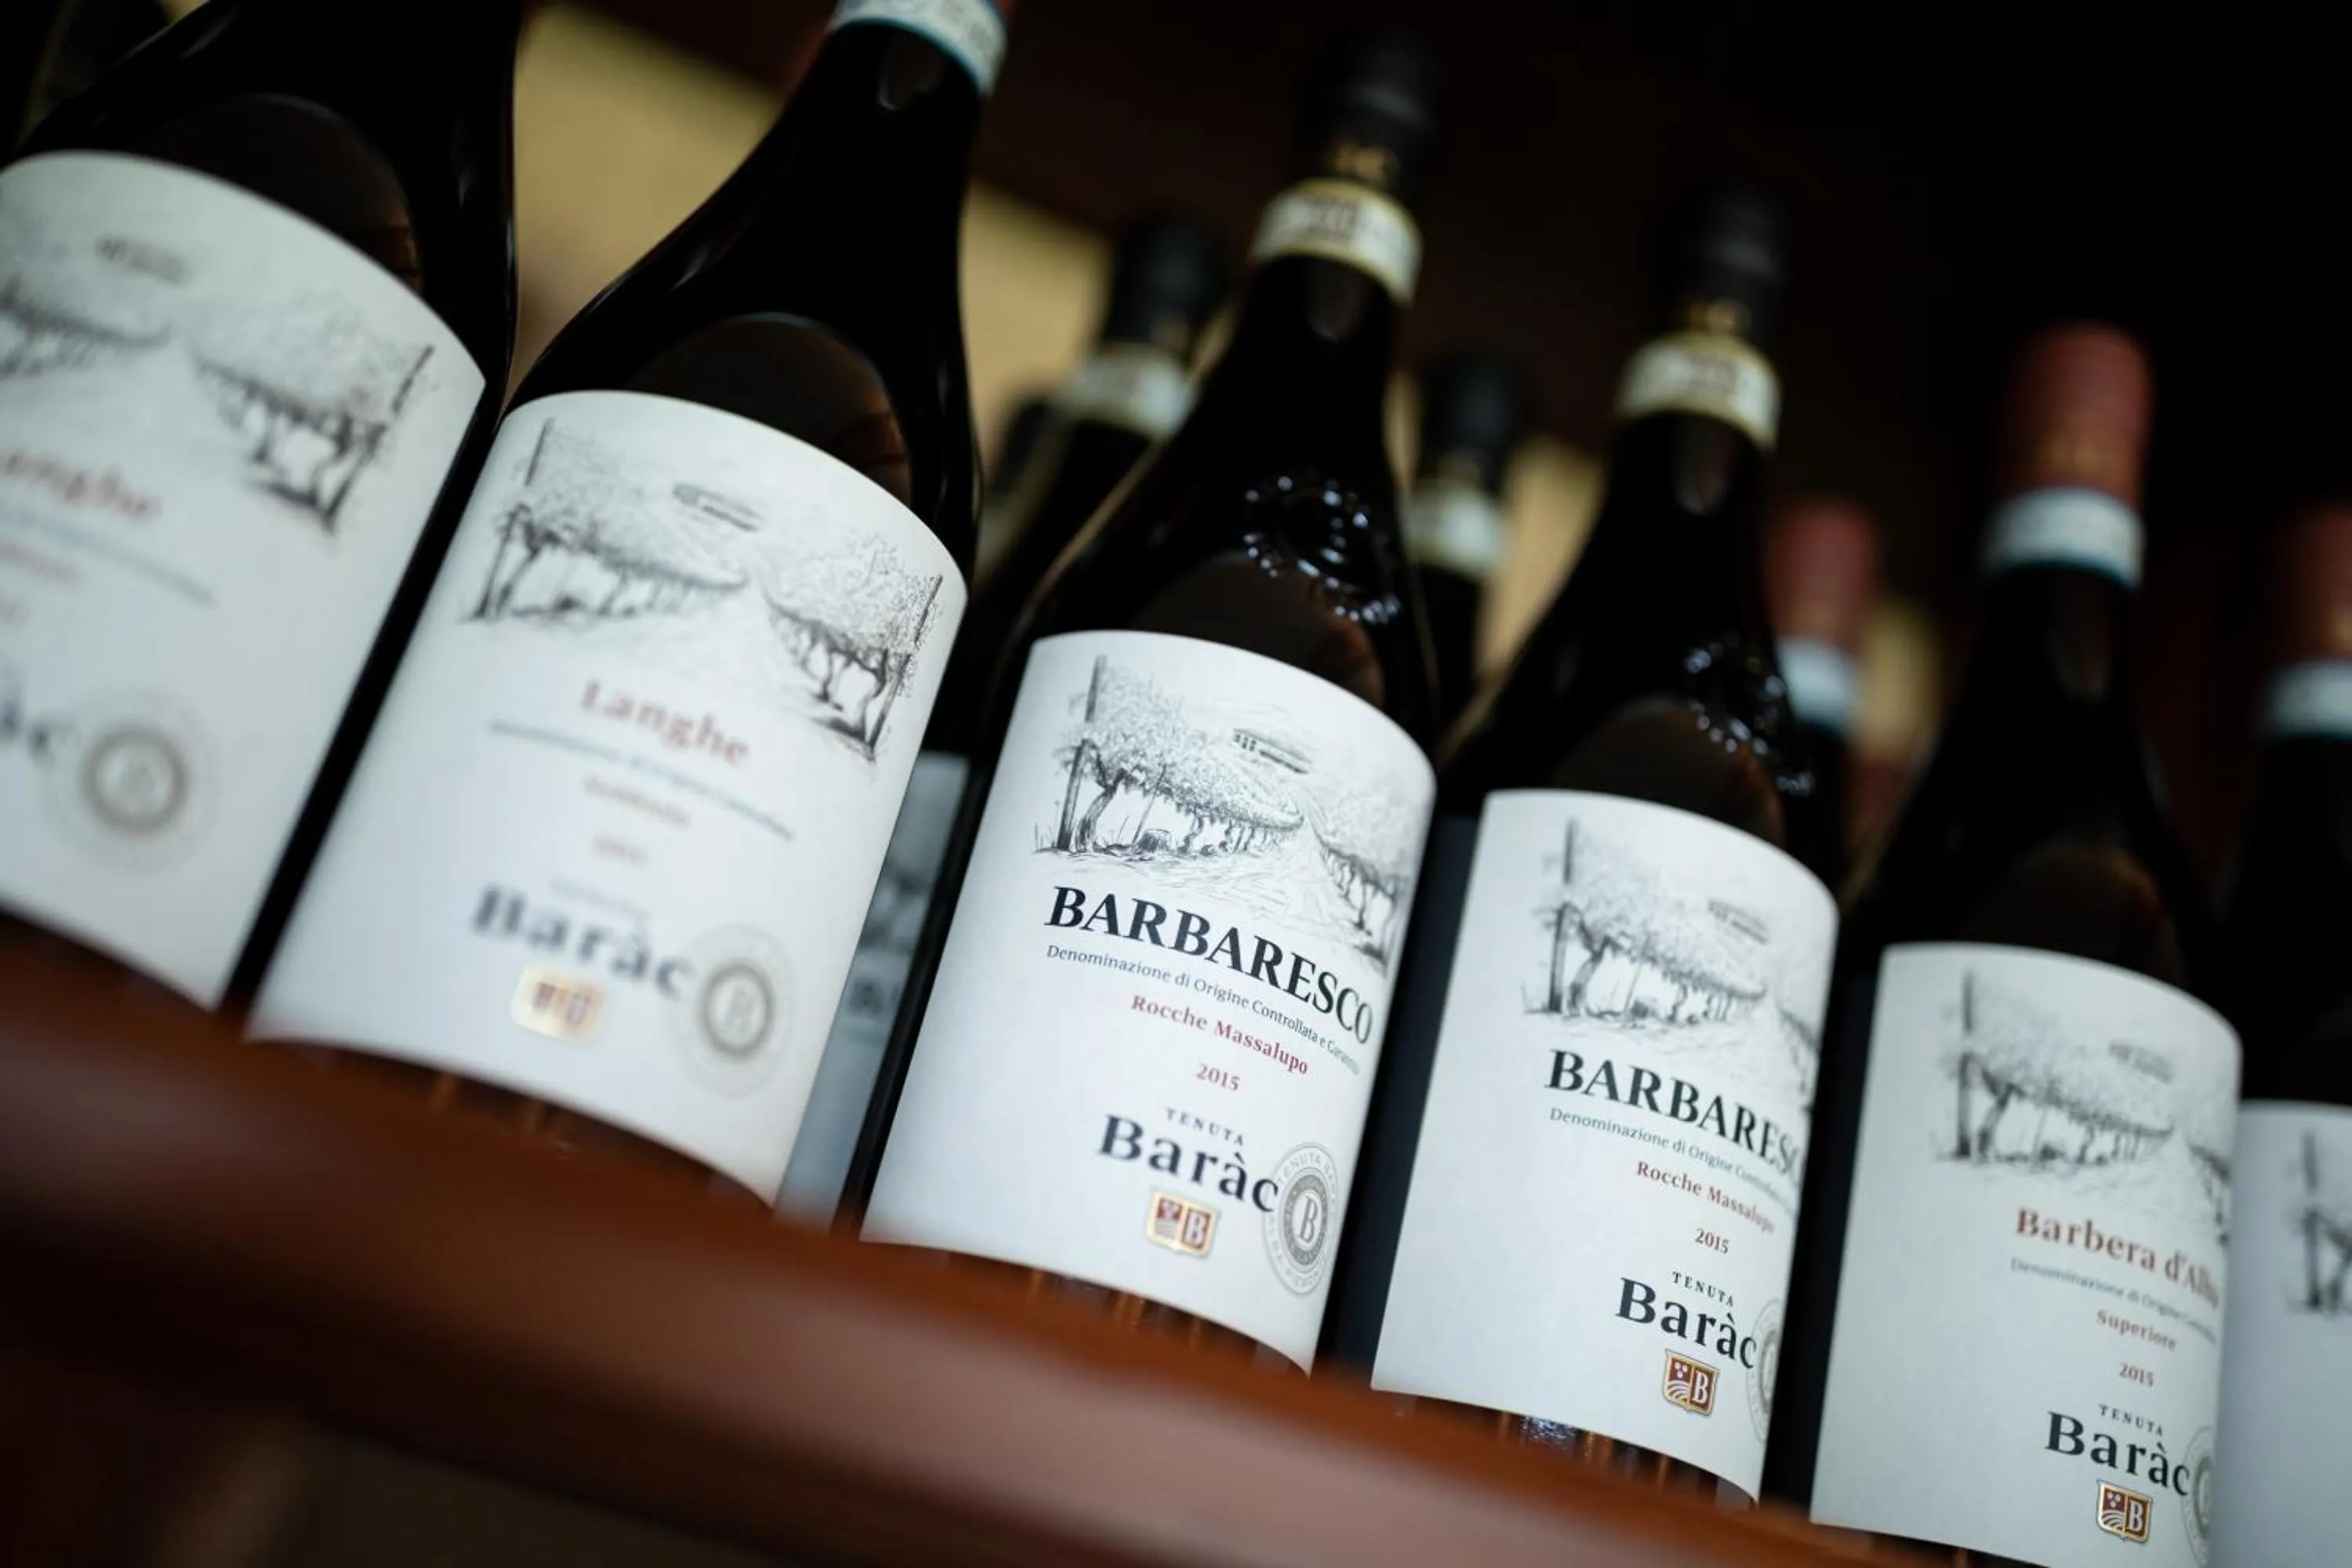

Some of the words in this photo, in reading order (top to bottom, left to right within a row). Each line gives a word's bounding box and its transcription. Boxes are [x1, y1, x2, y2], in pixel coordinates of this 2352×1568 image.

[1044, 886, 1373, 1044] BARBARESCO
[1046, 944, 1172, 982] Denominazione
[1175, 972, 1190, 989] di
[1193, 978, 1250, 1008] Origine
[1252, 1000, 1318, 1043] Controllata
[1319, 1037, 1327, 1048] e
[1131, 995, 1208, 1031] Rocche
[1214, 1020, 1309, 1075] Massalupo
[1196, 1063, 1241, 1091] 2015
[1166, 1107, 1244, 1146] TENUTA
[1544, 1048, 1801, 1189] BARBARES
[1550, 1107, 1670, 1149] Denominazione
[1672, 1140, 1686, 1154] di
[1688, 1145, 1733, 1173] Origine
[1098, 1113, 1279, 1213] Baràc
[1637, 1160, 1703, 1196] Rocche
[1694, 1228, 1730, 1254] 2015
[2016, 1207, 2156, 1273] Barbera
[1672, 1271, 1735, 1308] TENUTA
[1615, 1277, 1757, 1369] Baràc
[2096, 1308, 2177, 1352] Superiore
[1693, 1370, 1709, 1405] B
[2118, 1363, 2154, 1387] 2015
[2099, 1403, 2164, 1437] TENUTA
[2045, 1410, 2190, 1496] Baràc
[2127, 1501, 2143, 1532] B
